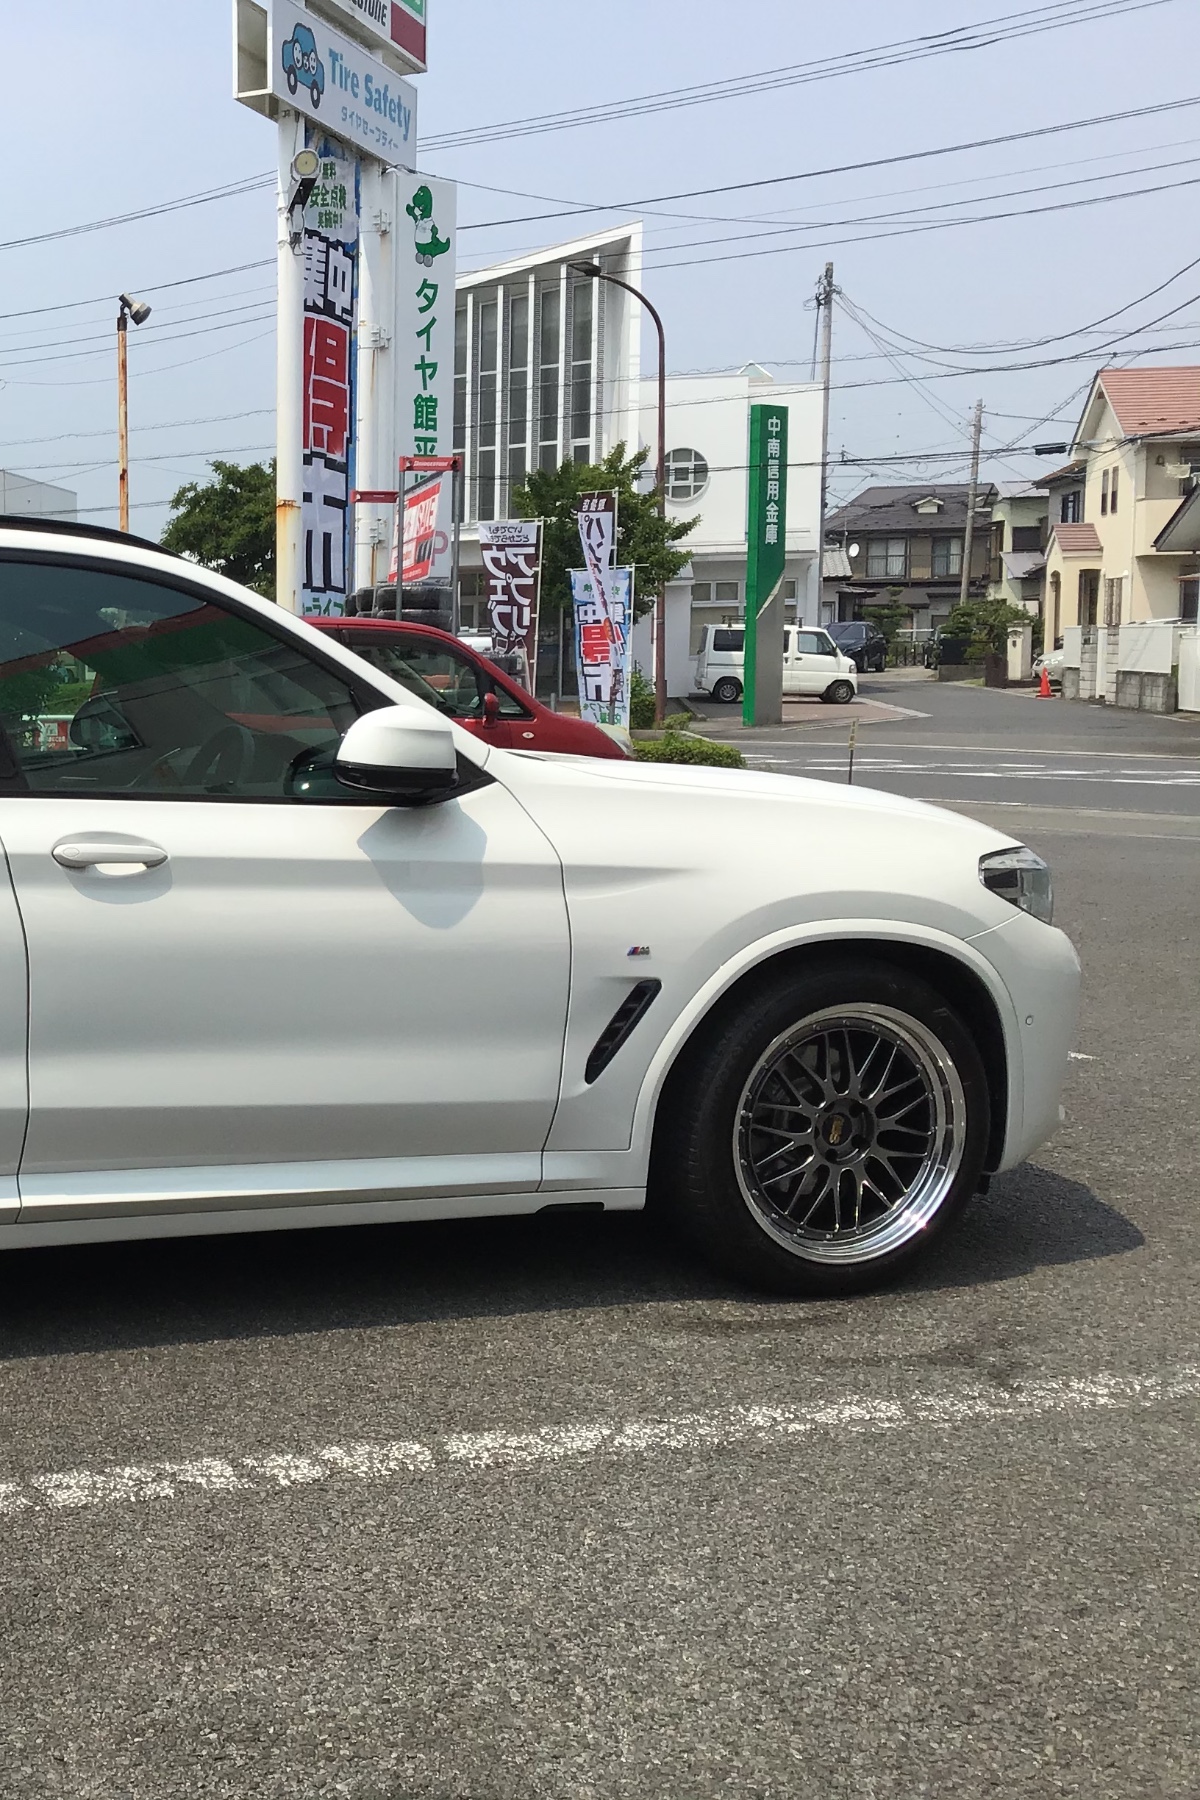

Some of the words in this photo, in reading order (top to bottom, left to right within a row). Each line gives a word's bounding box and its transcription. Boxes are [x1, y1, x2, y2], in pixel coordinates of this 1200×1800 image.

[328, 47, 359, 98] Tire
[364, 73, 411, 141] Safety
[341, 106, 398, 150] タイヤセーフティー
[309, 182, 347, 210] 安全点検
[413, 278, 439, 484] タイヤ館平
[764, 416, 781, 545] 中南信用金庫
[303, 597, 344, 616] ーライフ
